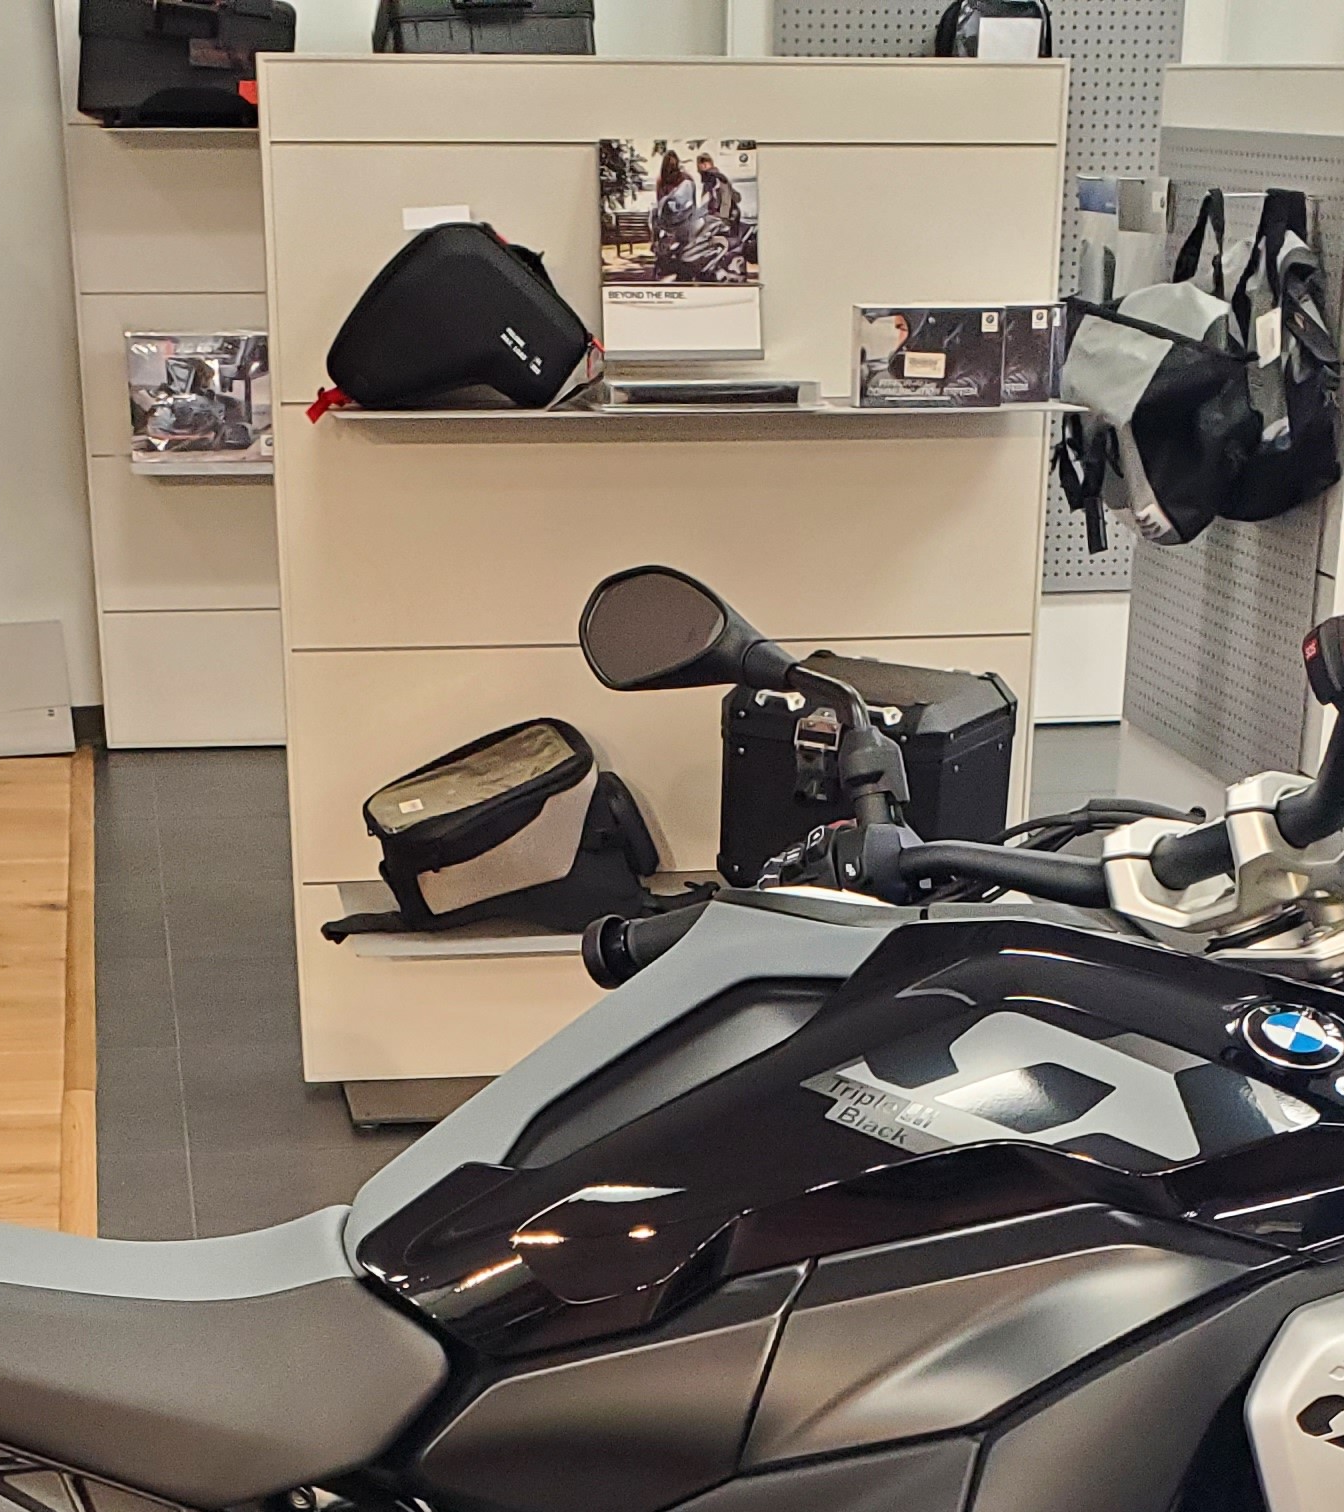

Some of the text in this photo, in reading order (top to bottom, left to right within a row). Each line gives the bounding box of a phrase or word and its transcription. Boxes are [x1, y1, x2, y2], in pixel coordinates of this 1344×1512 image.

[608, 291, 644, 299] BEYOND
[646, 291, 663, 299] THE
[837, 1106, 908, 1145] Black
